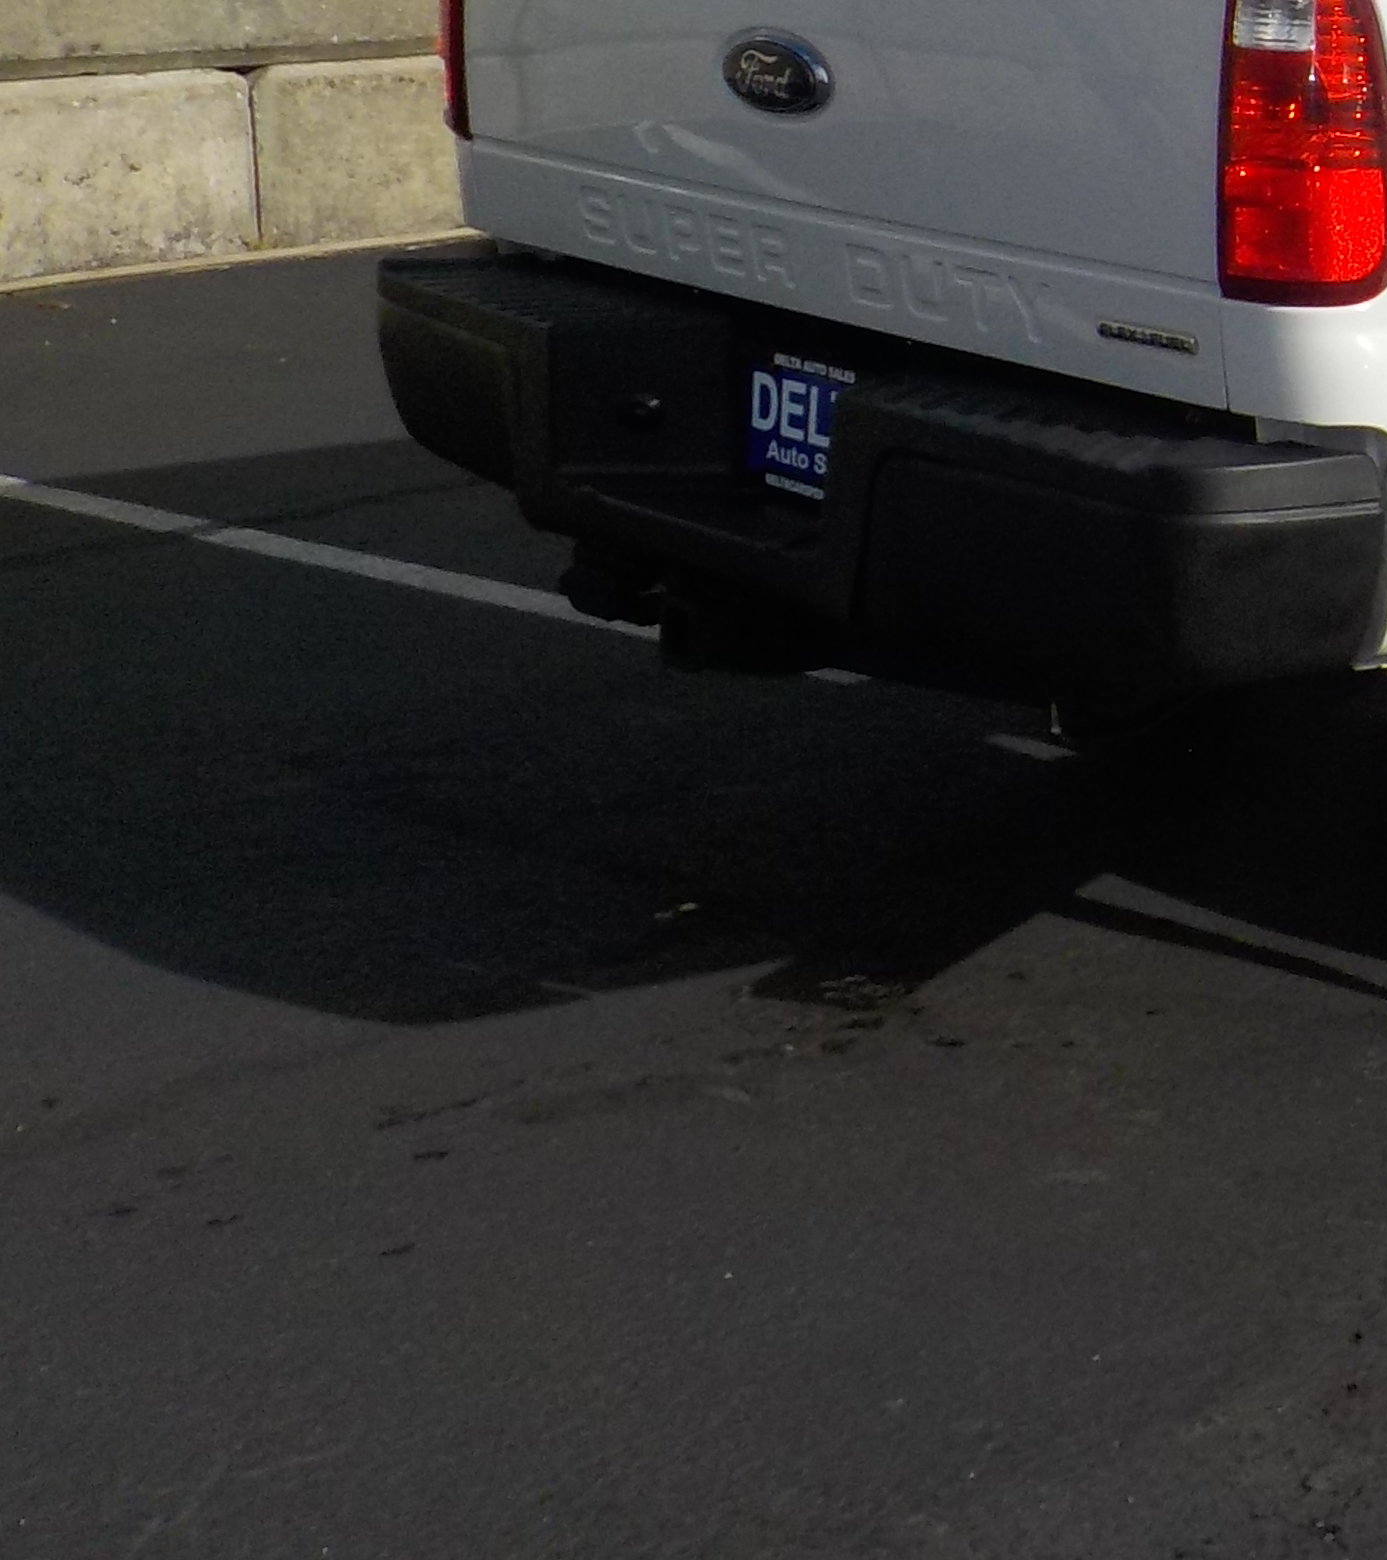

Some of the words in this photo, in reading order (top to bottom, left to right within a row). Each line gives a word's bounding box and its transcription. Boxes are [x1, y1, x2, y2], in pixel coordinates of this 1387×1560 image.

[735, 48, 794, 100] Ford
[579, 186, 797, 290] SUPER
[845, 243, 1048, 342] DUTY
[751, 370, 838, 448] DEL
[766, 440, 809, 470] Auto
